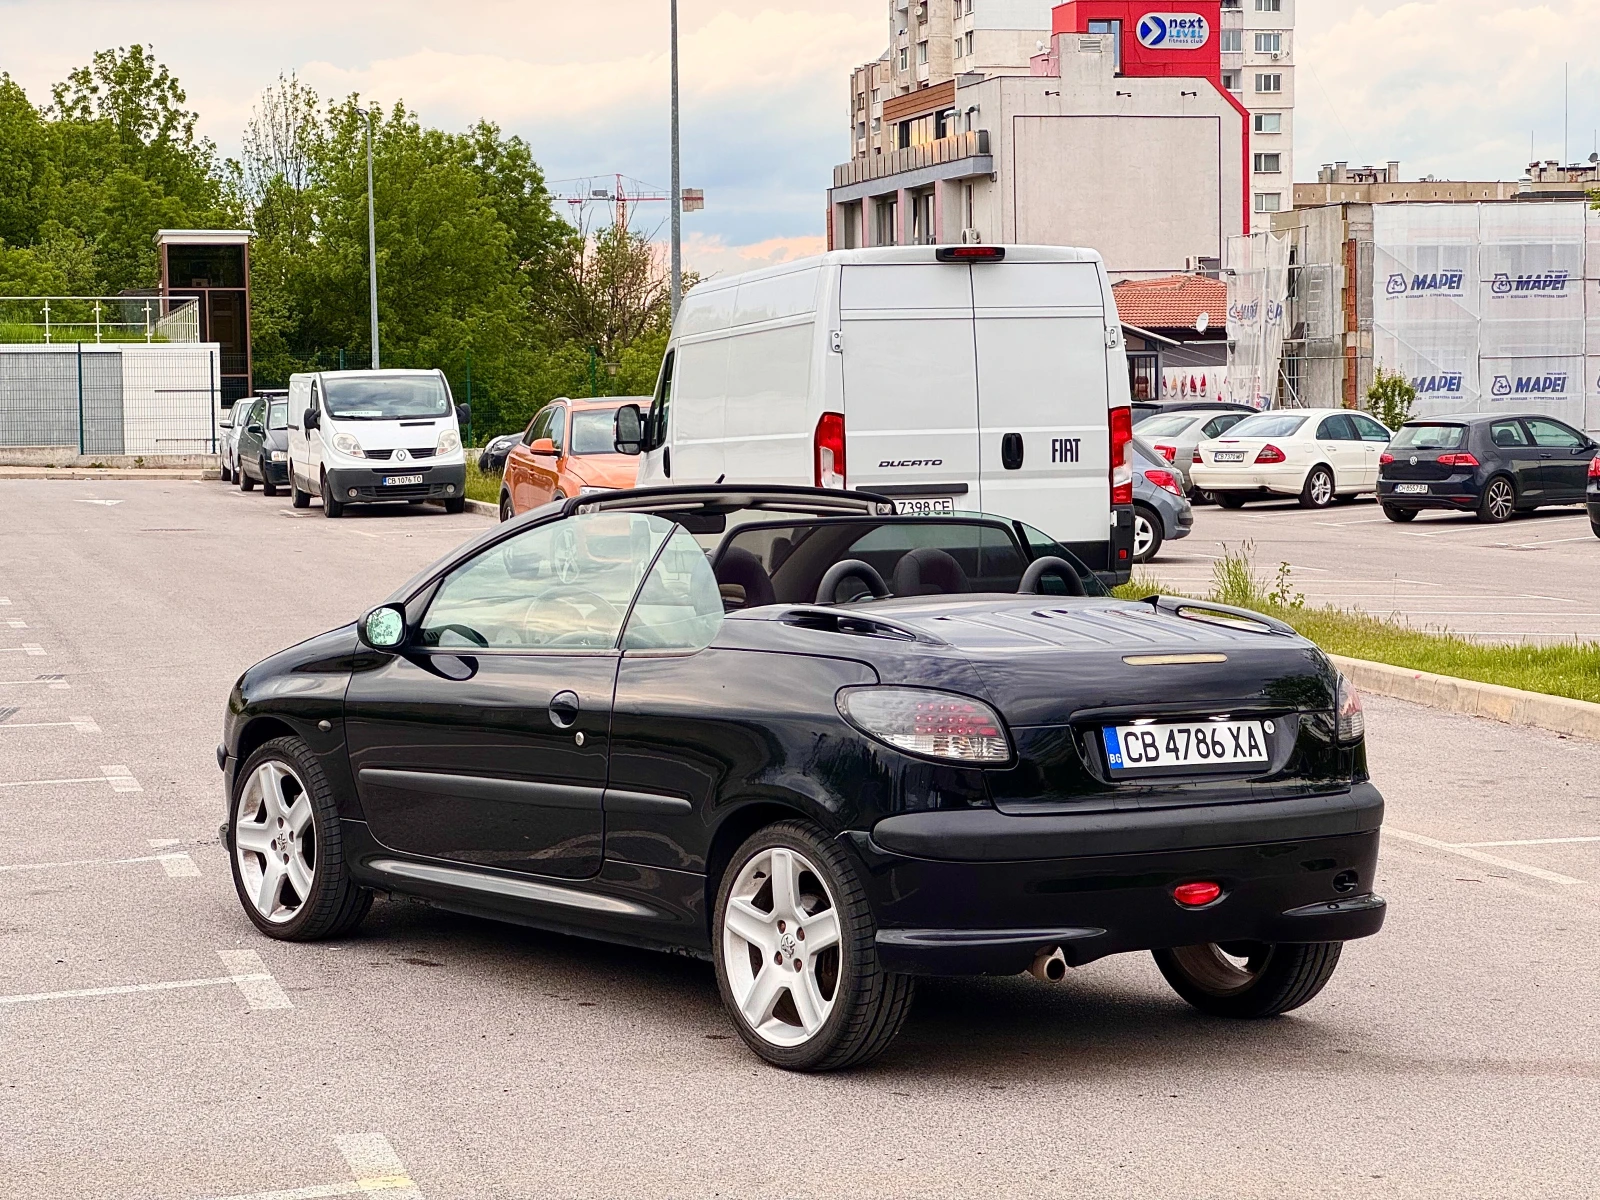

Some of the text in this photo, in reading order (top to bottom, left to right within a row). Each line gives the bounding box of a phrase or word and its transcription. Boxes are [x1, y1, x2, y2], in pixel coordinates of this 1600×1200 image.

[1169, 17, 1203, 28] next
[1169, 30, 1203, 38] LEVEL
[1411, 273, 1463, 290] MAPEI
[1515, 275, 1567, 290] MAPEI
[1515, 376, 1566, 392] MAPEI
[1051, 439, 1080, 462] FIAT
[878, 459, 942, 467] DUCATO
[899, 501, 950, 515] 7398 CE
[1110, 726, 1262, 763] BG CB 4786 XA
